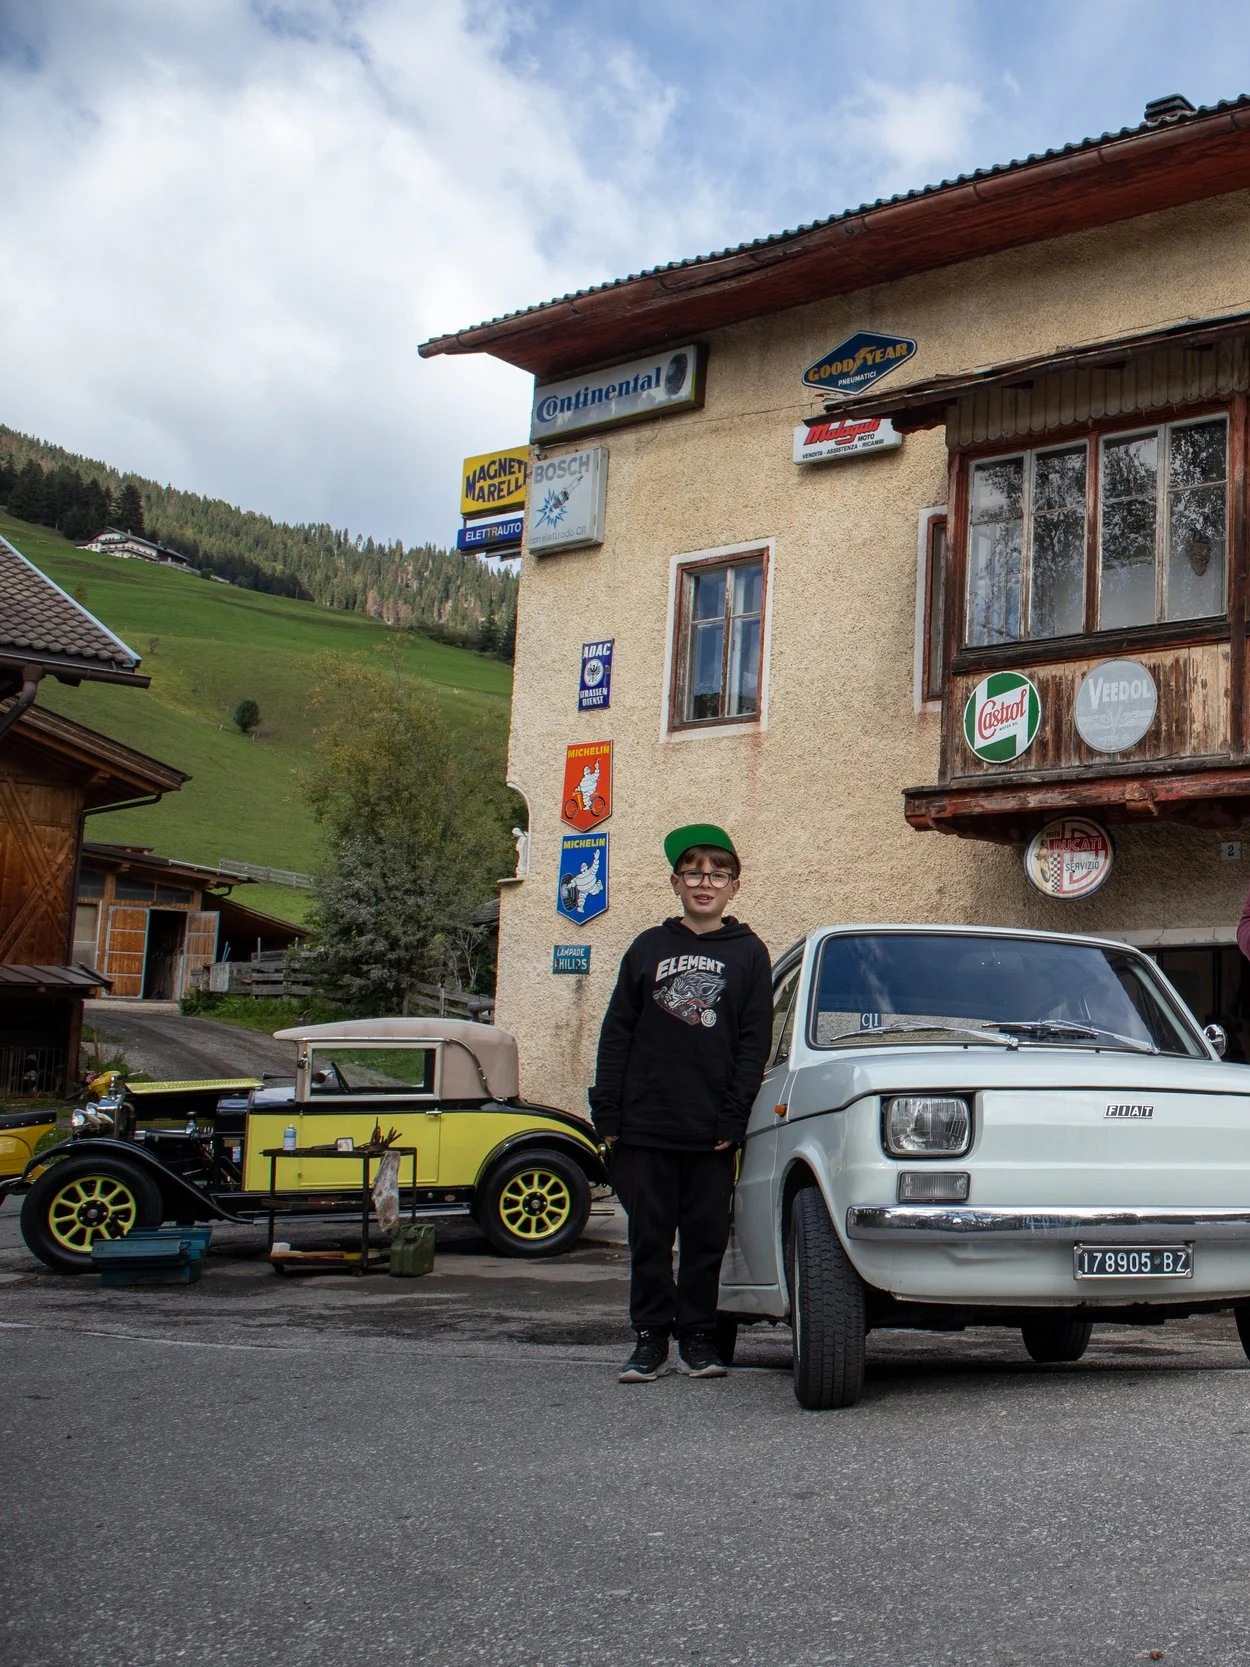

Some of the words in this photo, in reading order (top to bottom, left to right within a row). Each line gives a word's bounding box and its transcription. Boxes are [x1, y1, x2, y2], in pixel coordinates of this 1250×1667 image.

[838, 371, 877, 386] PNEUMATICI
[536, 366, 661, 423] Continental
[857, 433, 875, 442] MOTO
[802, 450, 823, 459] VENDITA
[826, 444, 858, 455] ASSISTENZA
[861, 438, 885, 448] RICAMBI
[533, 453, 591, 485] BOSCH
[465, 522, 522, 542] ELETTRAUTO
[583, 643, 611, 659] ADAC
[1088, 676, 1151, 711] VEEDOL
[582, 696, 604, 707] DIENST
[977, 688, 1028, 741] Castrol
[567, 745, 610, 759] MICHELIN
[563, 838, 606, 850] MICHELIN
[1054, 837, 1102, 851] DUCATI
[1227, 845, 1235, 857] 2
[1065, 861, 1100, 872] SERVIZIO
[556, 948, 586, 957] LAMPADE
[655, 955, 727, 982] ELEMENT
[1106, 1105, 1153, 1117] FIAT
[1083, 1252, 1151, 1273] 178905
[1163, 1252, 1186, 1272] BZ
